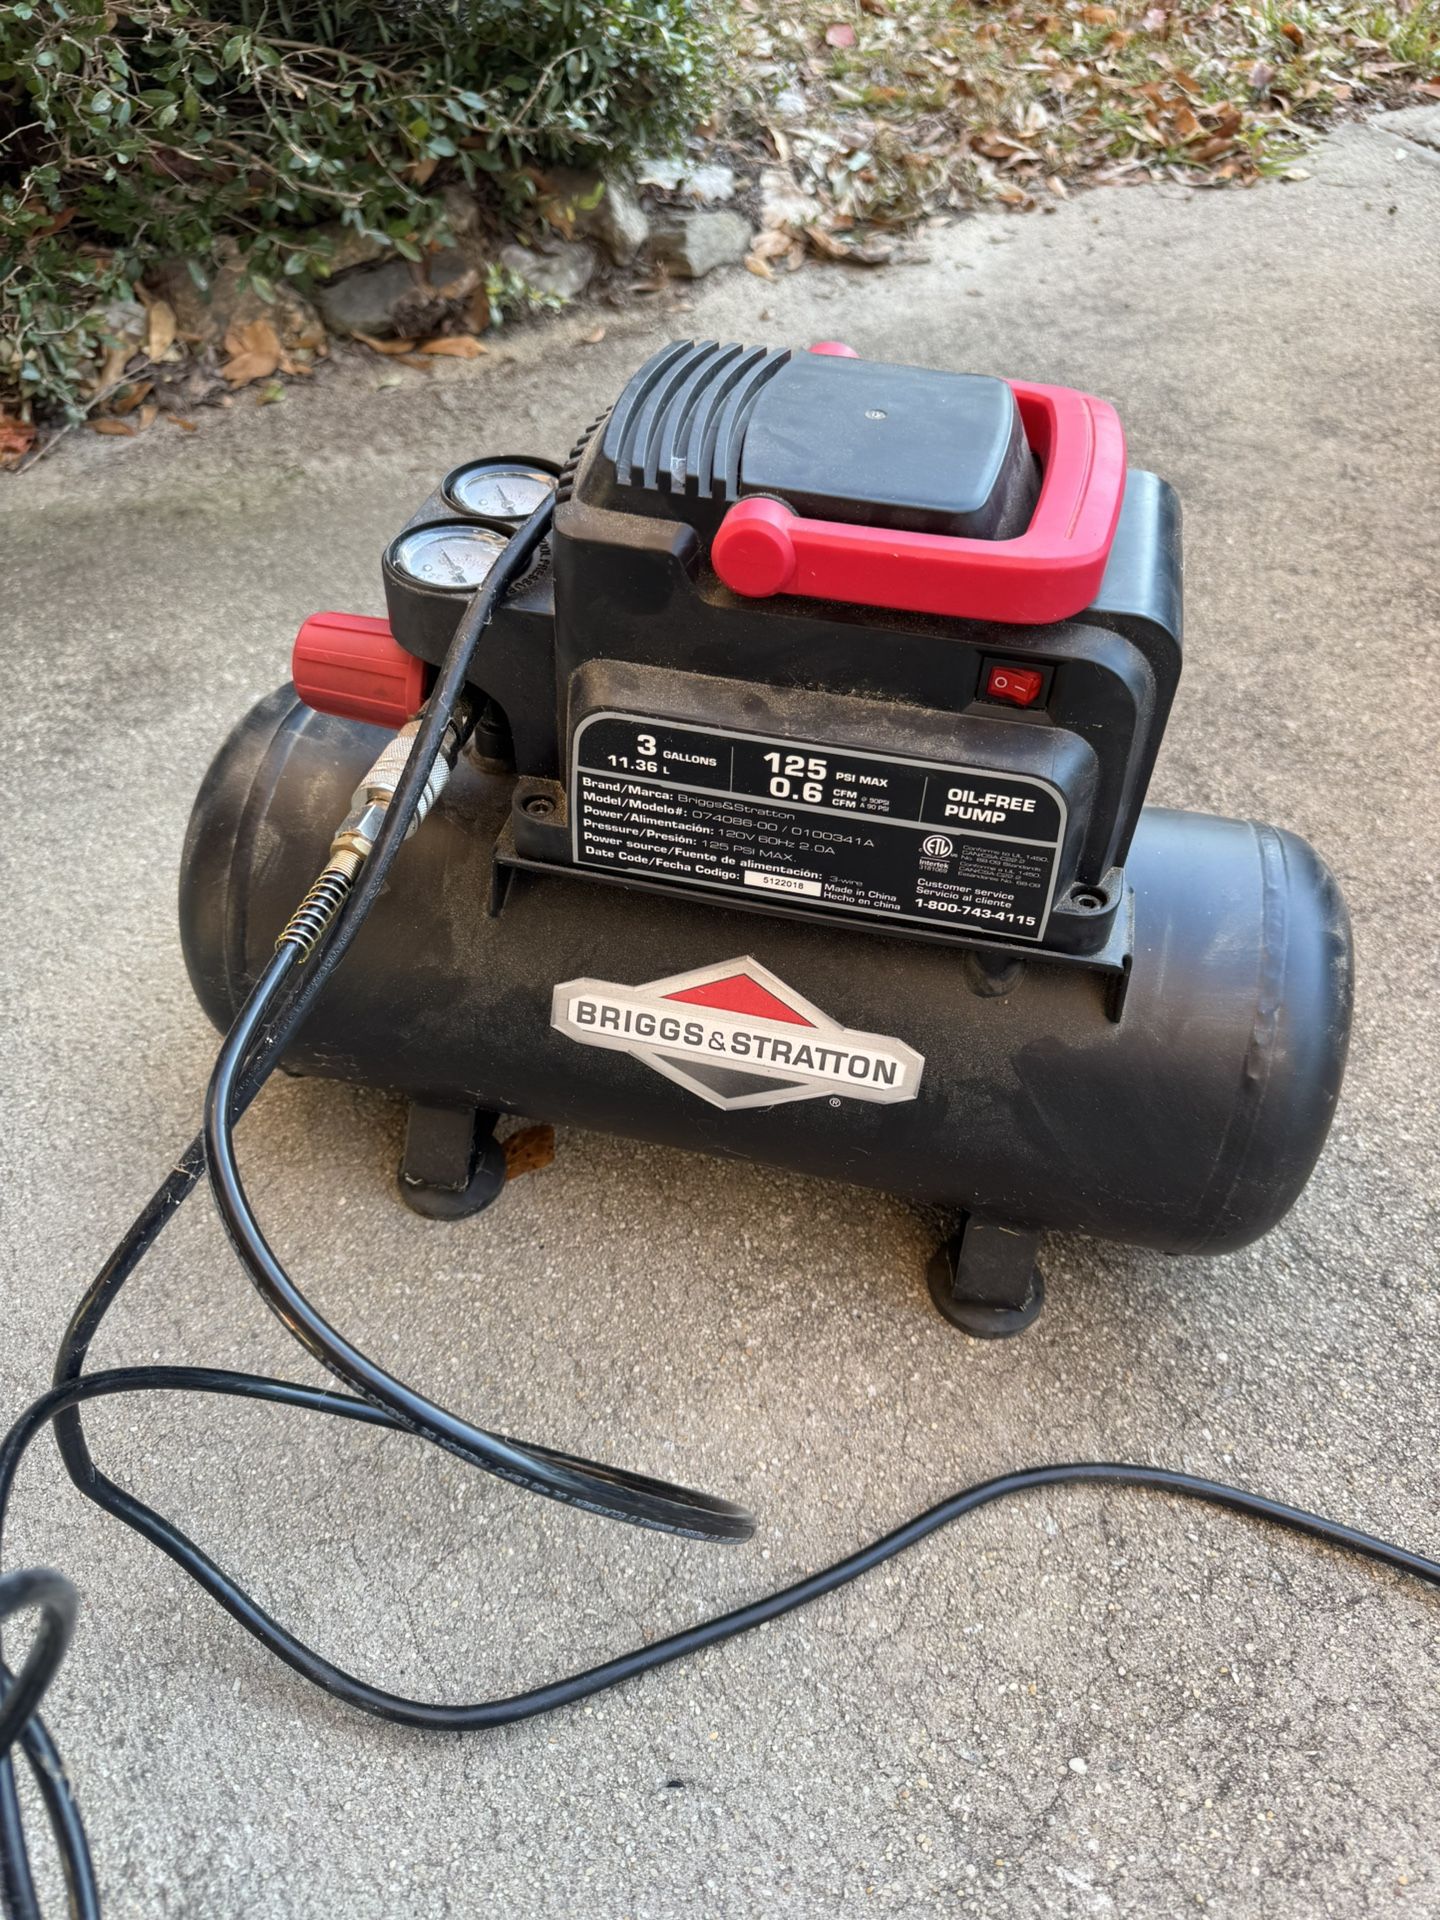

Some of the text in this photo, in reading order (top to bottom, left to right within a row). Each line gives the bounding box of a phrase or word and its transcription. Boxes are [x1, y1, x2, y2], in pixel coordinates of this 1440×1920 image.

[637, 734, 717, 767] 3 GALLONS
[608, 755, 670, 775] 11.36 L
[764, 752, 888, 788] 125 PSI MAX
[582, 777, 795, 820] Brand/Marca: Briggs&Stratton
[770, 777, 823, 803] 0.6
[833, 788, 858, 799] CFM
[948, 788, 1036, 813] OIL-FREE
[832, 798, 856, 808] CFM
[944, 805, 1006, 824] PUMP
[583, 791, 875, 848] Model/Modelo#: 074086-00 / 0100341A
[583, 805, 835, 855] Power/Alimentación: 120V 60Hz 2.0A
[583, 818, 796, 863] Pressure/Presión: 125 PSI MAX.
[583, 831, 863, 887] Power source/Fuente de alimentación: 3-wire
[585, 845, 804, 890] Date Code/Fecha Codigo: 5122018
[919, 859, 949, 869] Intertek
[823, 891, 855, 903] Hecho
[873, 900, 901, 910] china
[824, 883, 897, 902] Made in China
[916, 886, 1012, 909] Servicio al cliente
[917, 878, 1015, 900] Customer service
[915, 898, 1036, 926] 1-800-743-4115
[418, 1425, 437, 1440] DE
